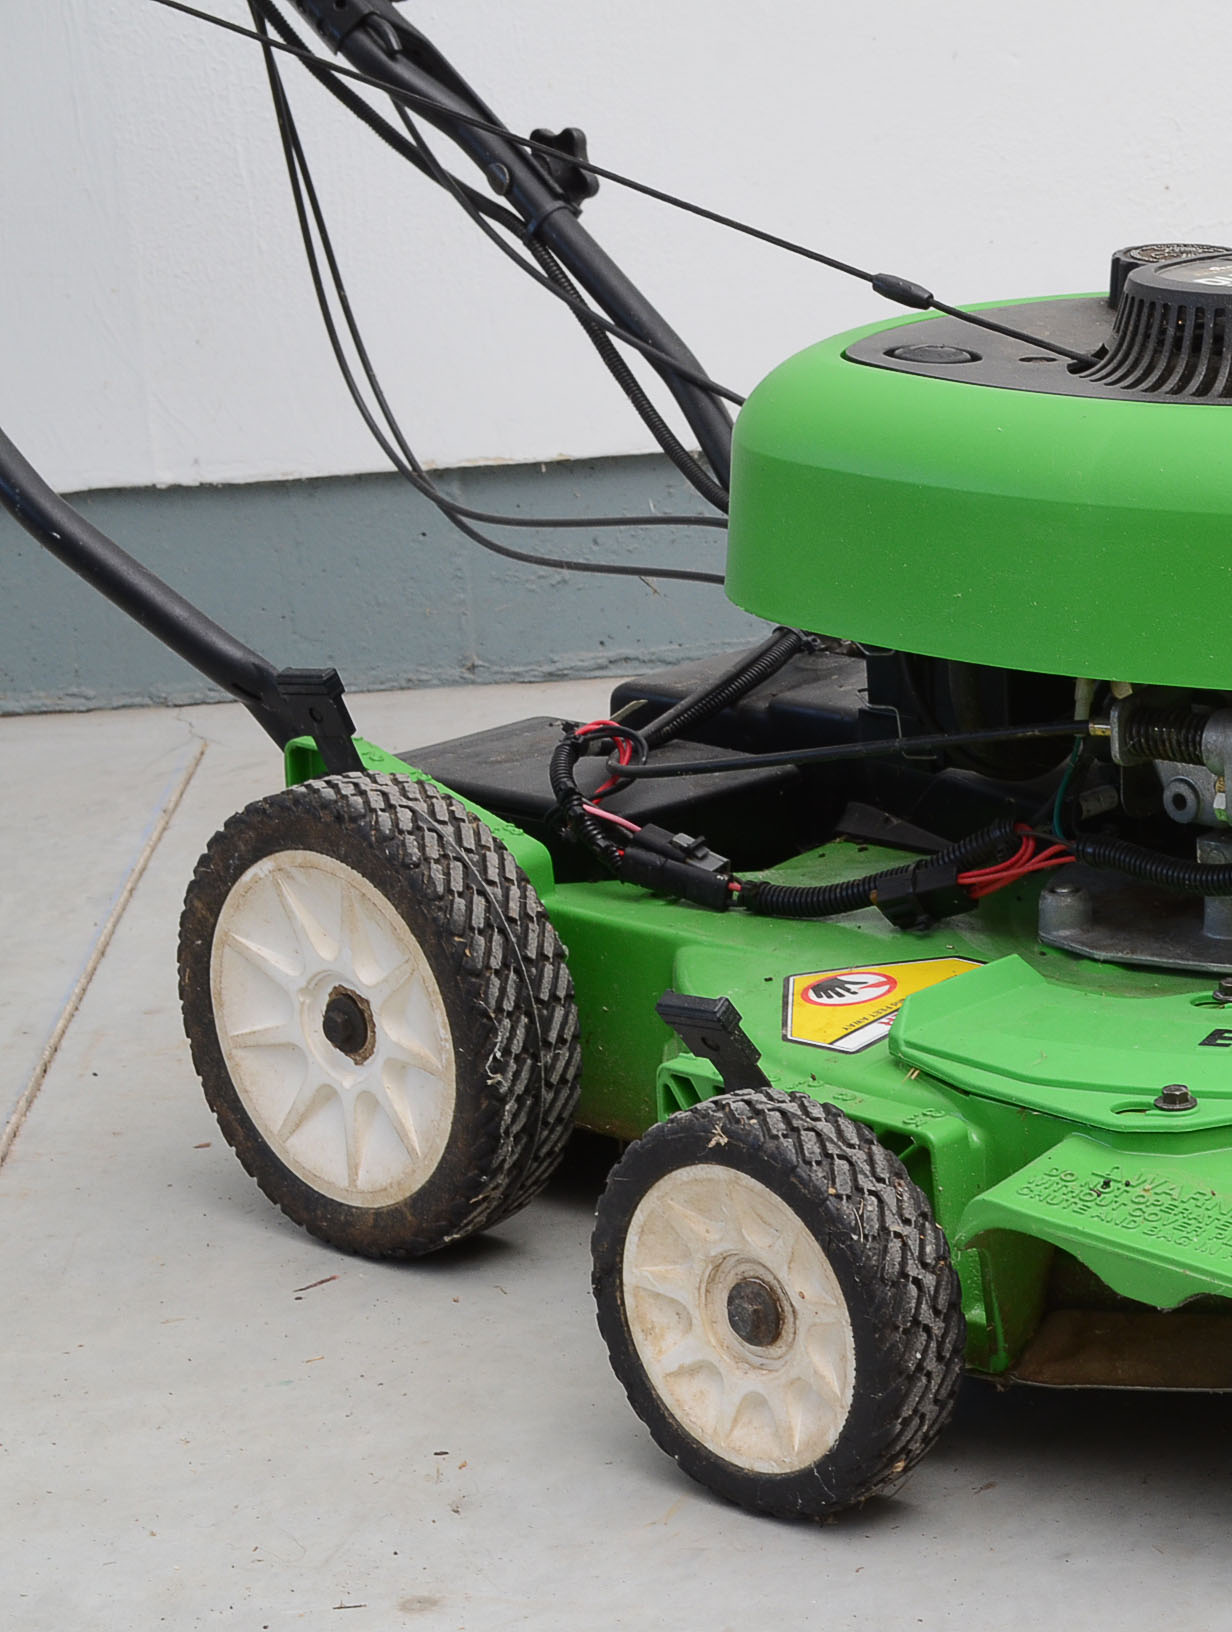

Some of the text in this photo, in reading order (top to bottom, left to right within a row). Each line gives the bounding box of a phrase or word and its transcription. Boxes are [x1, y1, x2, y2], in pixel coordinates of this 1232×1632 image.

[1026, 1176, 1128, 1211] WITHOUT
[1129, 1207, 1206, 1237] COVER
[1043, 1167, 1078, 1182] DO
[1079, 1180, 1130, 1198] NOT
[1016, 1186, 1092, 1215] CHUTE
[1090, 1212, 1140, 1230] AND
[1142, 1225, 1193, 1247] BAG
[1194, 1241, 1219, 1255] IN
